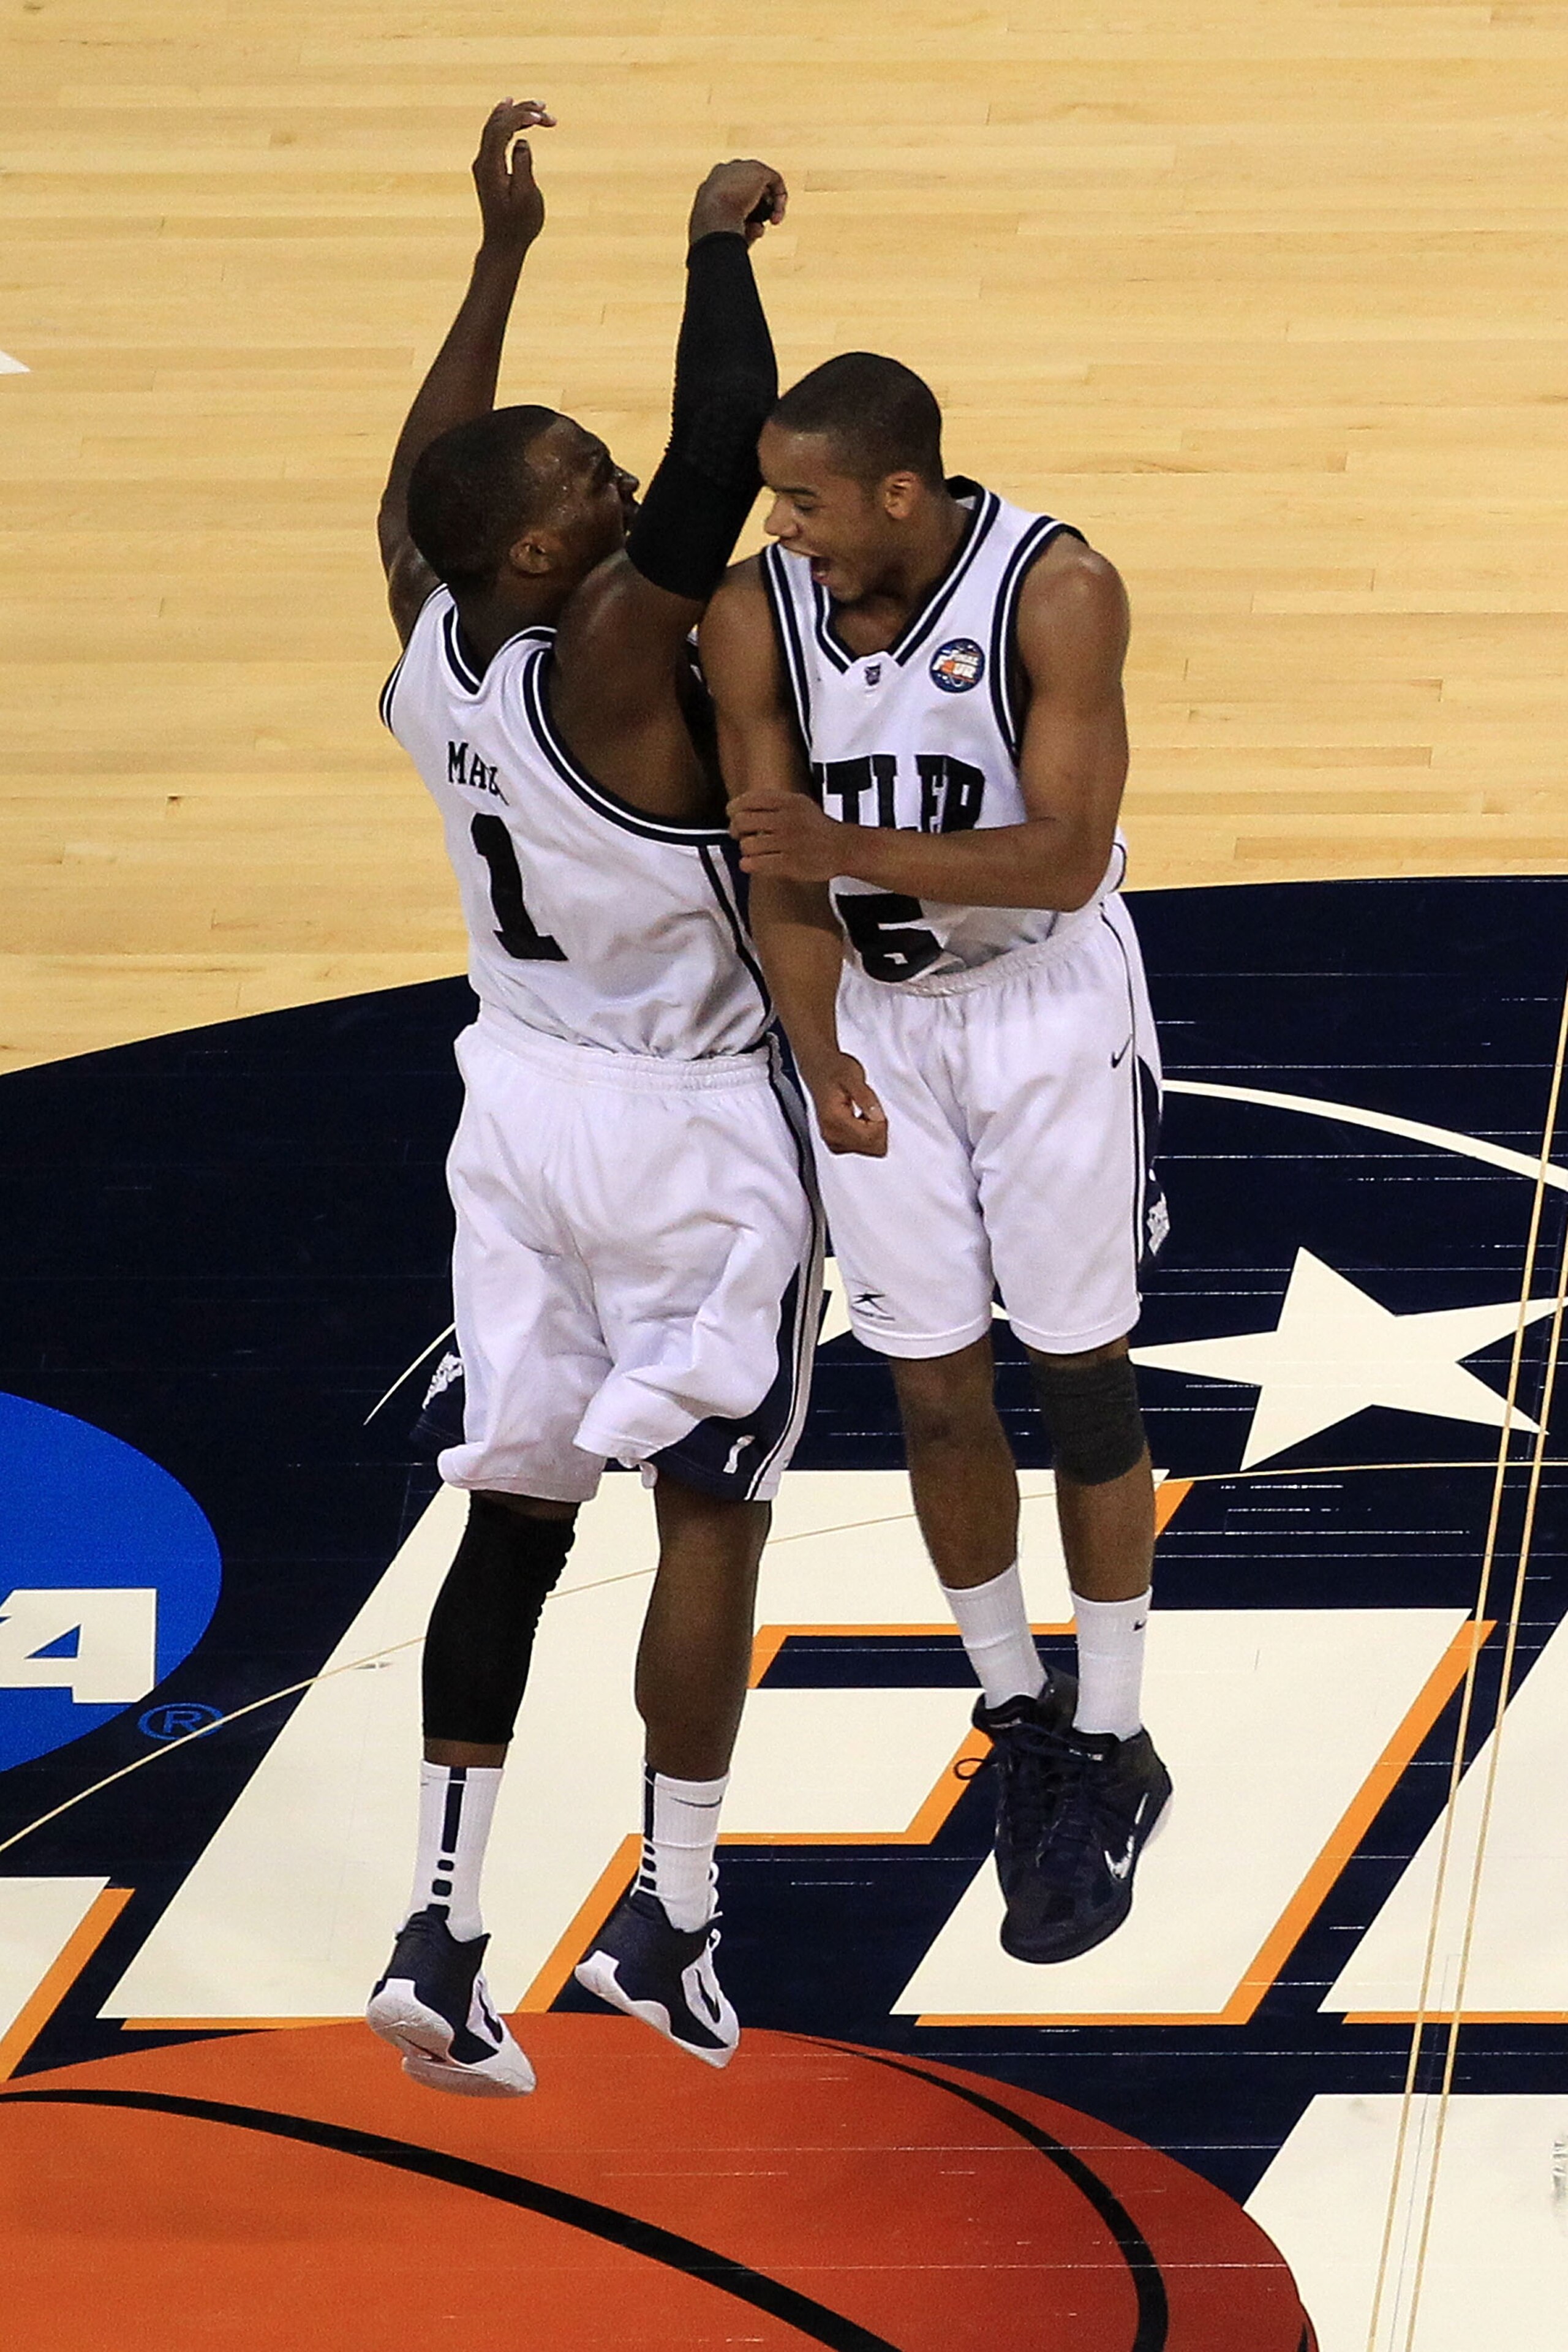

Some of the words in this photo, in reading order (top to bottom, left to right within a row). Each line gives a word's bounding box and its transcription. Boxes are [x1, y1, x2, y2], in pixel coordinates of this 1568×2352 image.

[813, 753, 986, 834] TLER
[470, 812, 569, 961] 1
[835, 892, 944, 983] 5
